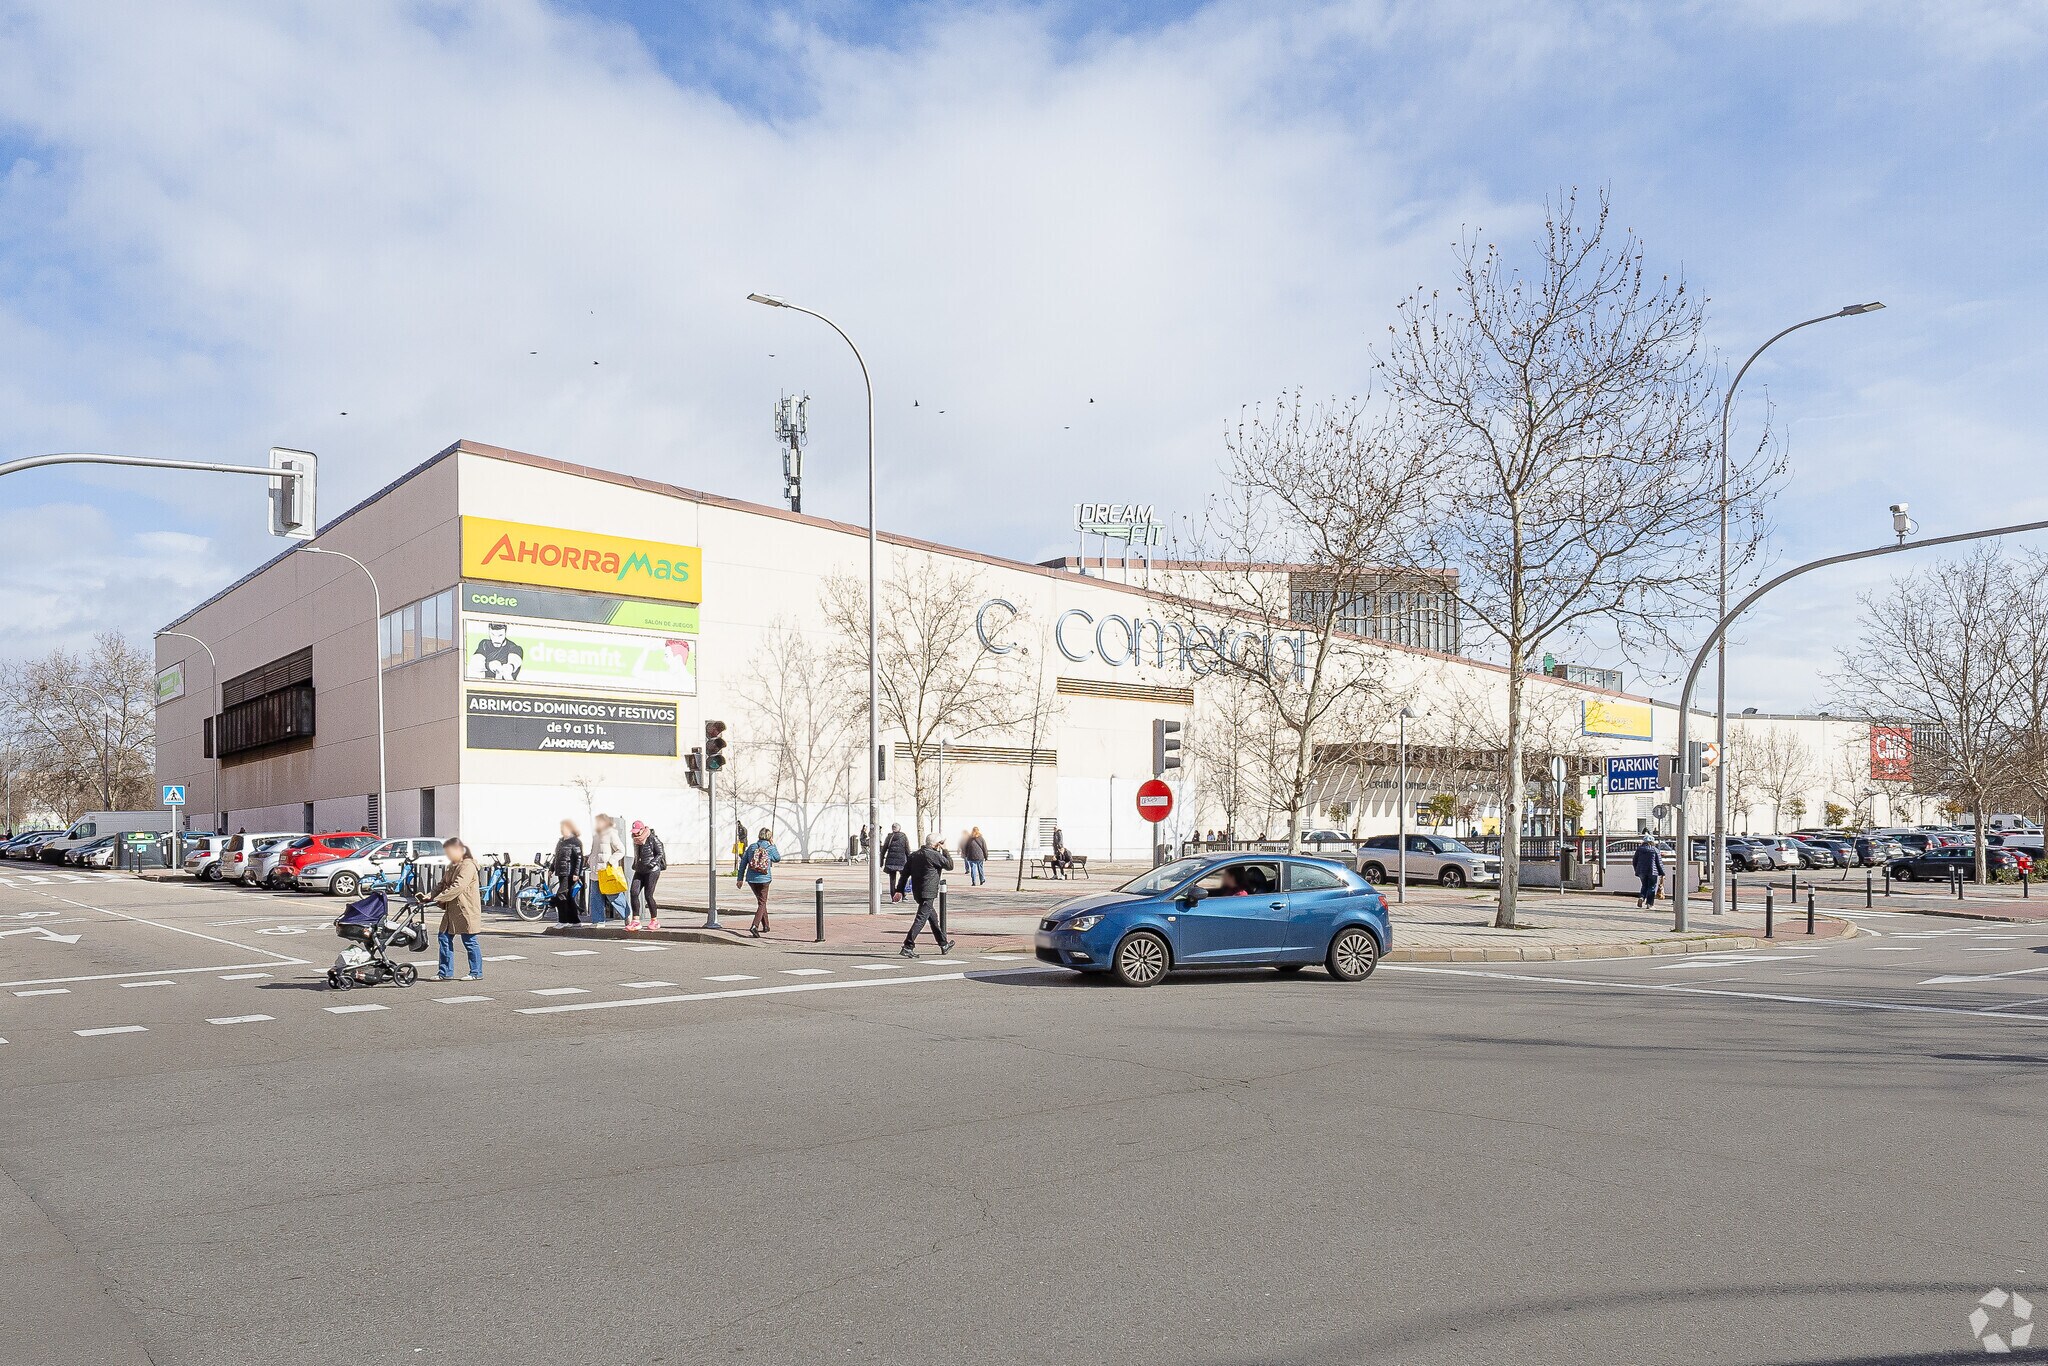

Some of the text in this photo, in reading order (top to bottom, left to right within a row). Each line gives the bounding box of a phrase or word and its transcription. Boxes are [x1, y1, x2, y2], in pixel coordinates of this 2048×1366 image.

[1080, 503, 1155, 524] DREAM
[1129, 524, 1166, 546] FIT
[471, 593, 518, 608] codere
[1056, 608, 1306, 682] comercial
[469, 698, 675, 721] ABRIMOS DOMINGOS Y FESTIVOS
[547, 722, 607, 735] de 9 a 15 h.
[1611, 757, 1659, 772] PARKING
